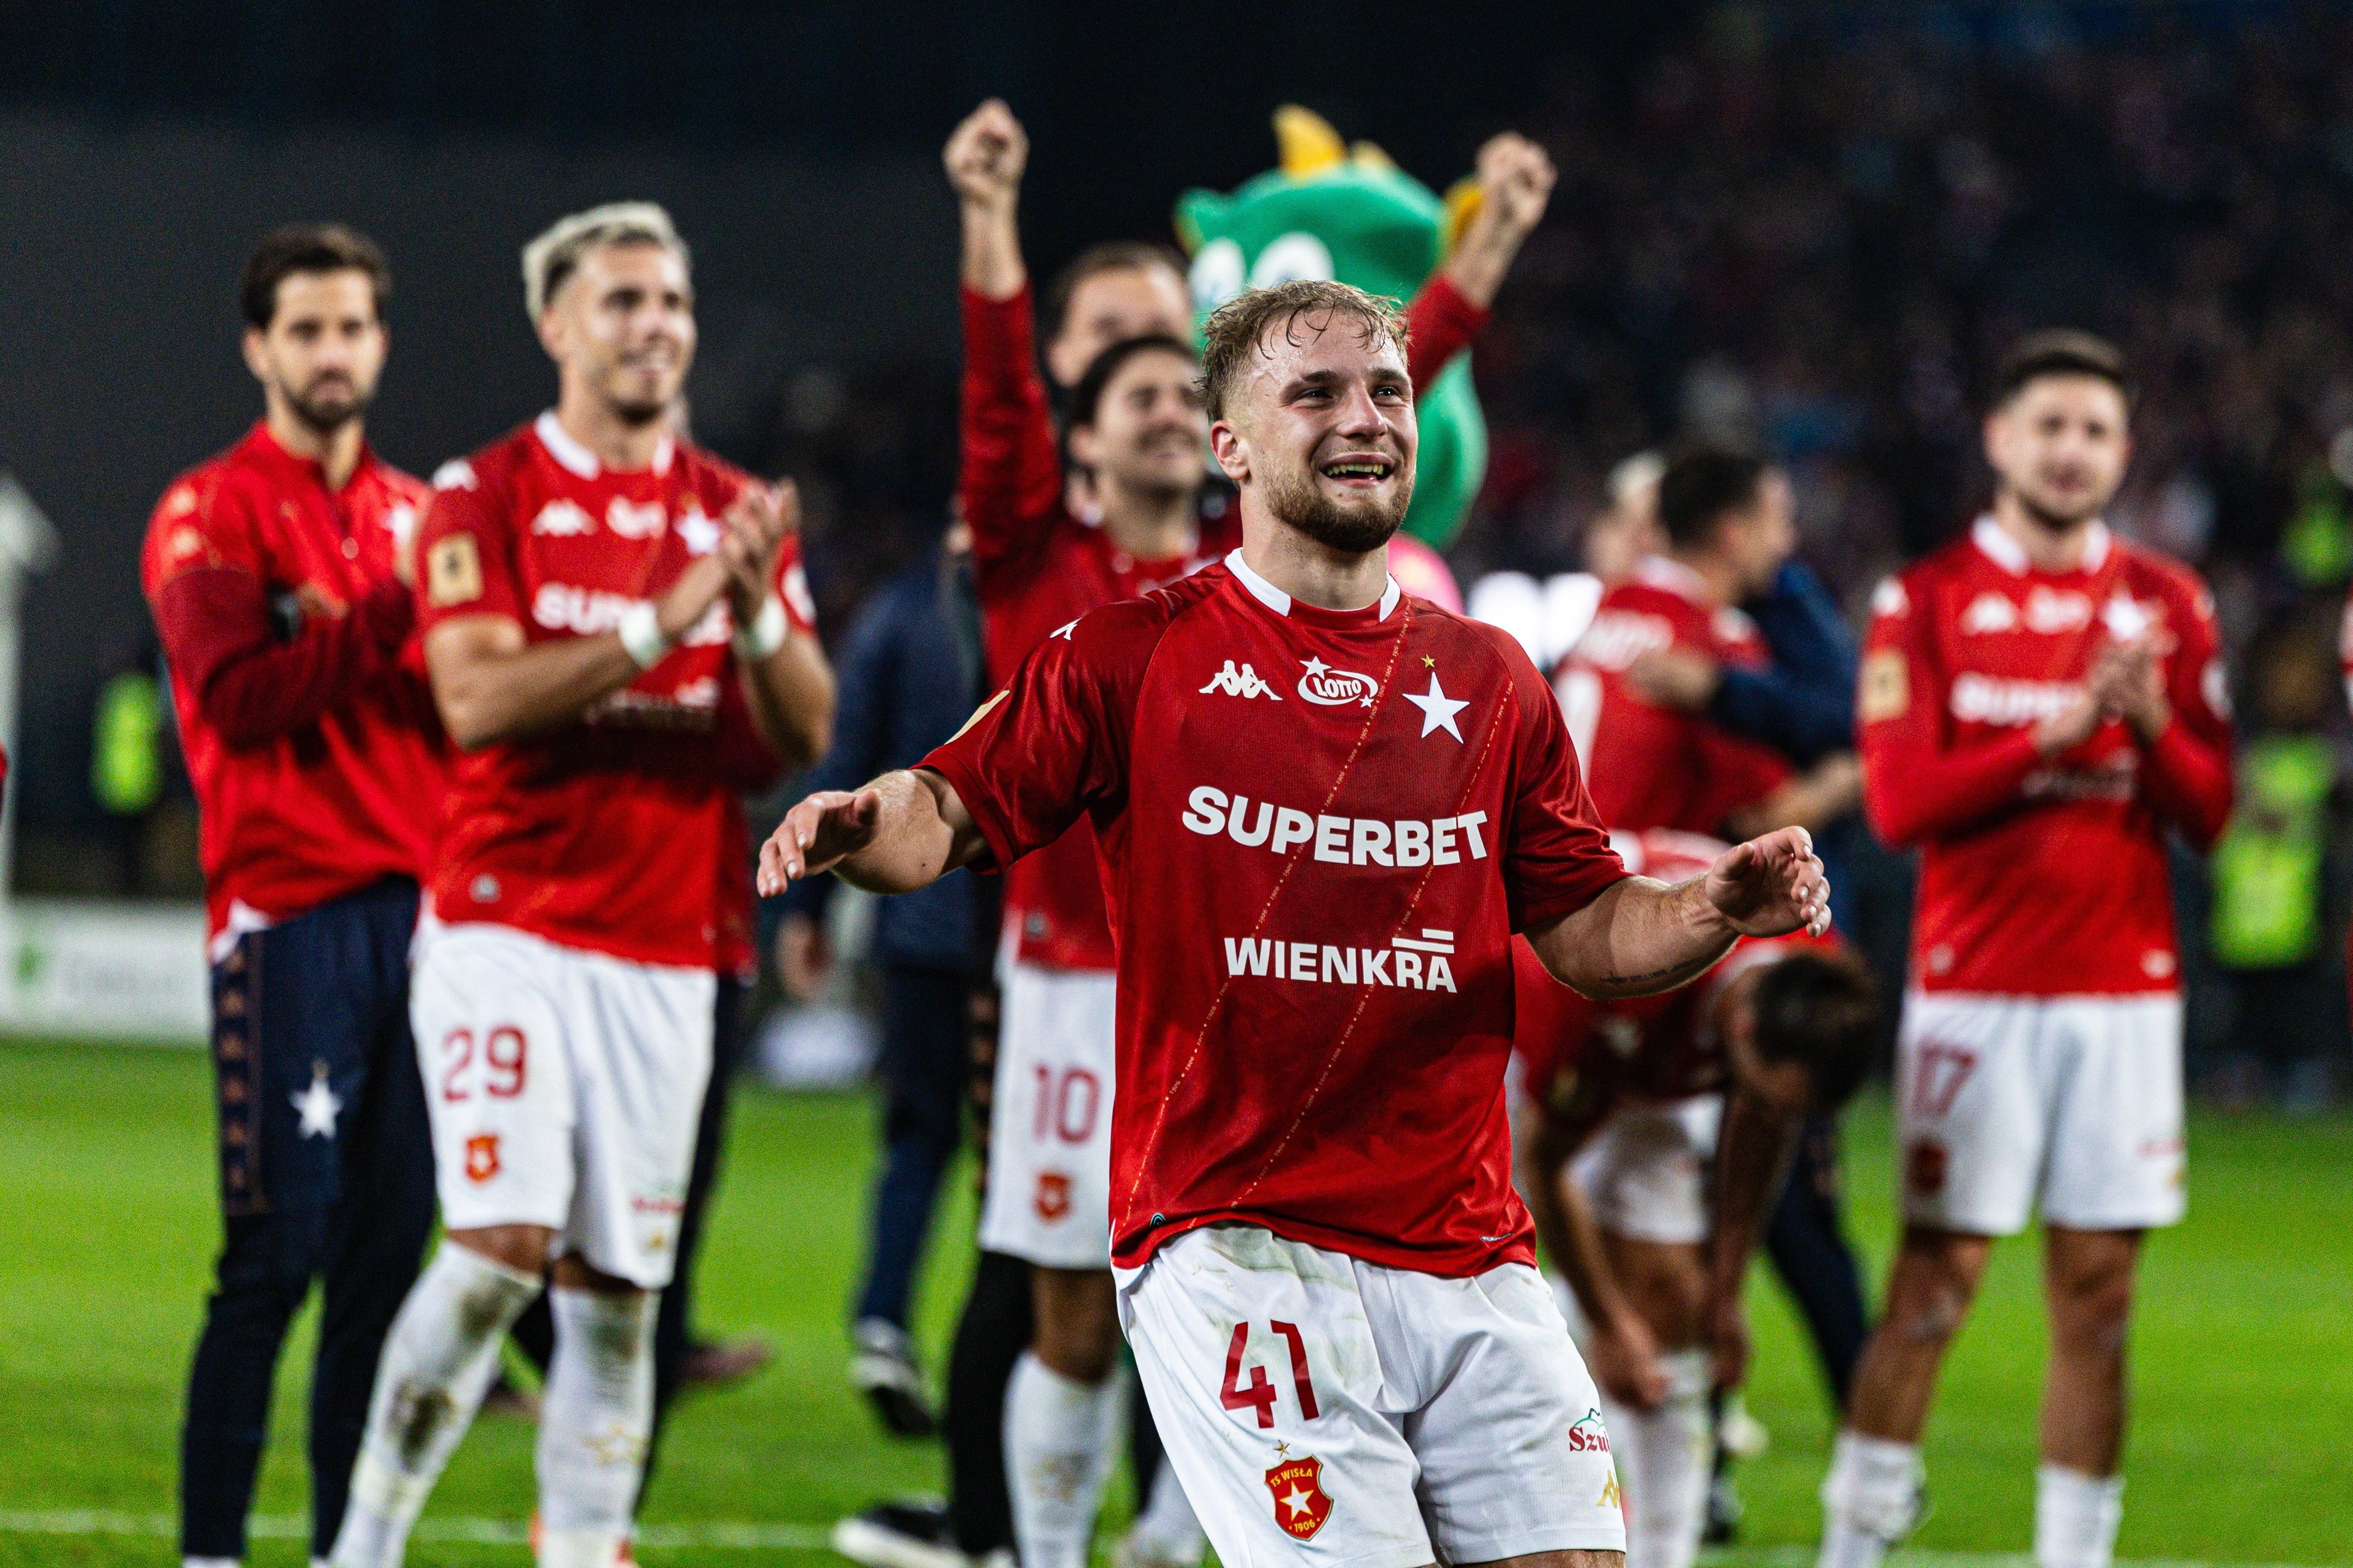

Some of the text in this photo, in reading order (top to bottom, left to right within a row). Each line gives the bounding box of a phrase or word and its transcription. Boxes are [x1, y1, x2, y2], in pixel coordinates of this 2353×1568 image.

[1312, 677, 1361, 698] LOTTO
[1182, 785, 1488, 867] SUPERBET
[1224, 937, 1457, 993] WIENKRA
[442, 1025, 527, 1103] 29
[1032, 1062, 1100, 1145] 10
[1220, 1319, 1320, 1429] 41
[1270, 1468, 1313, 1488] TS WISŁA
[1294, 1519, 1316, 1533] 1906
